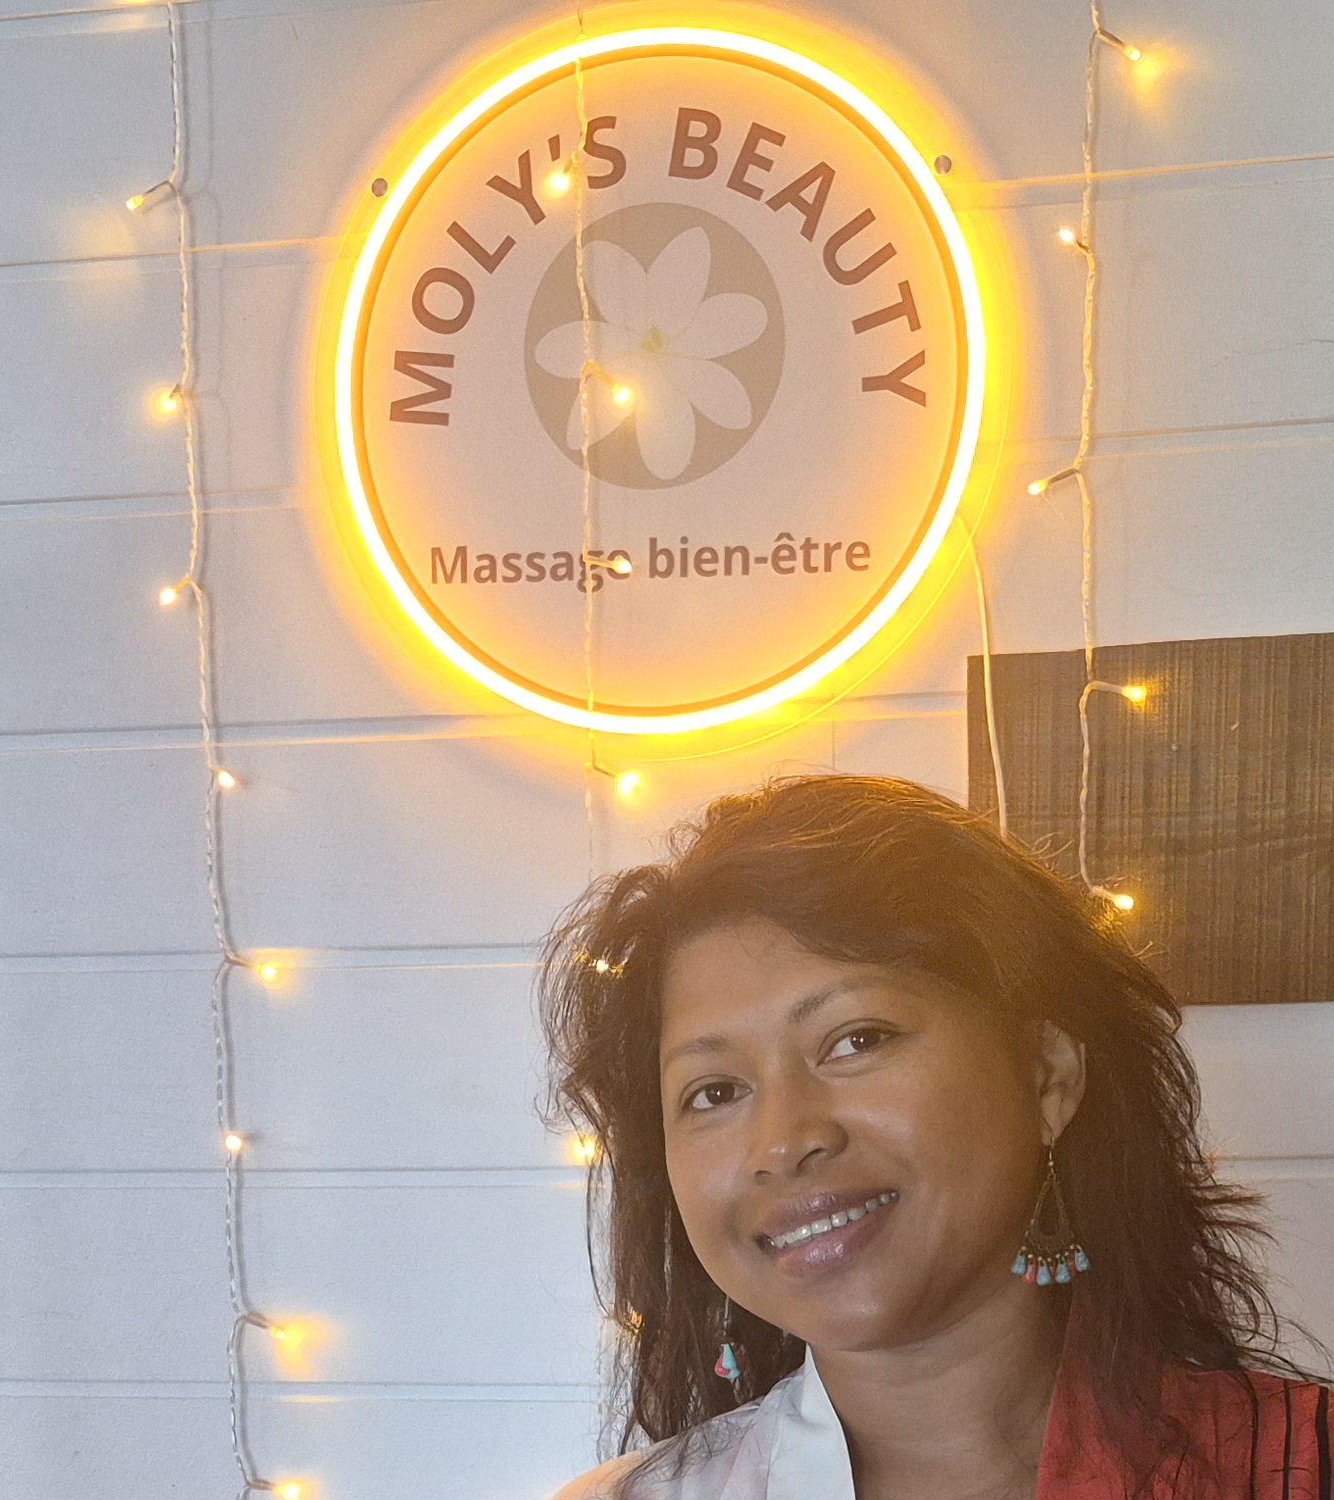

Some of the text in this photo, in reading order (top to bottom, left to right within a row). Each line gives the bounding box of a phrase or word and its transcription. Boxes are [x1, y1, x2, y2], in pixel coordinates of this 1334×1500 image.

[389, 107, 927, 427] MOLY'S BEAUTY
[647, 532, 873, 580] bien-être
